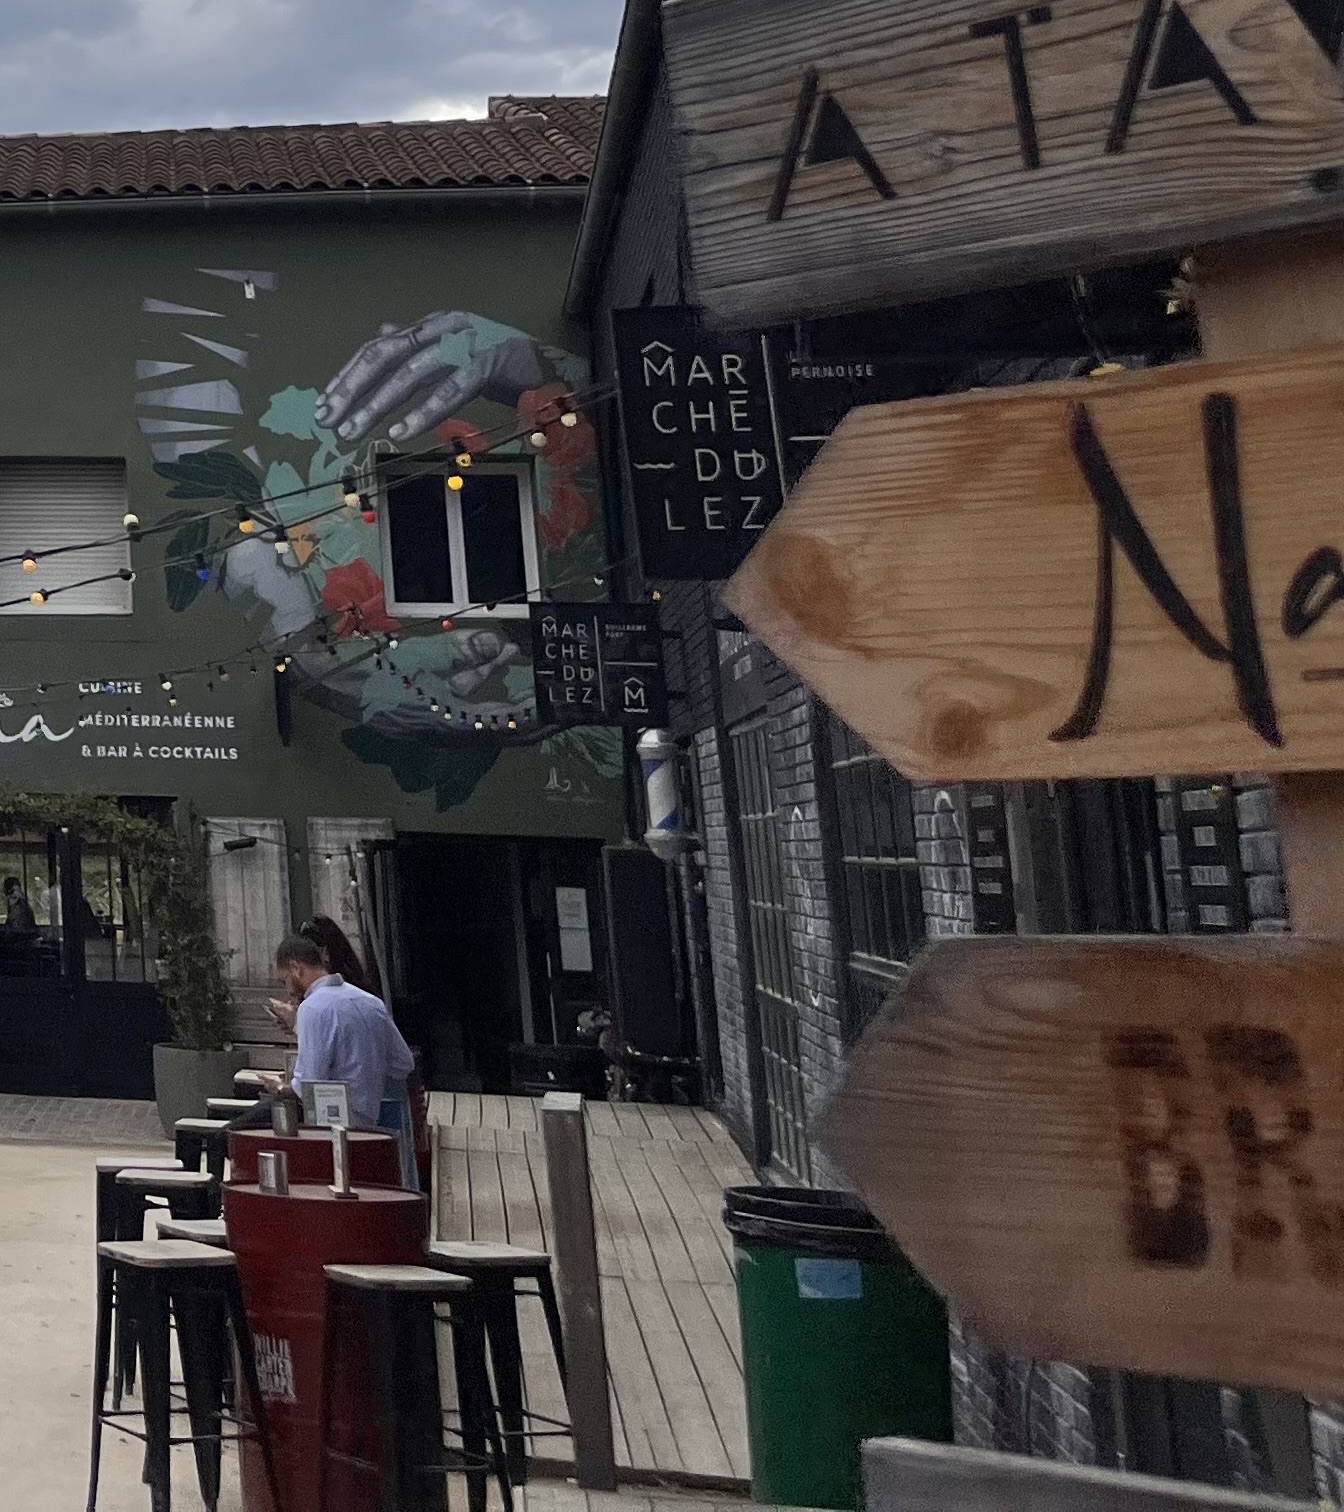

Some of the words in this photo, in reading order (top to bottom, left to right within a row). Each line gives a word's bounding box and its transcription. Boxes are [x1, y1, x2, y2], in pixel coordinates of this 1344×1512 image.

[664, 496, 766, 531] LEZ
[97, 745, 128, 758] BAR
[148, 745, 239, 760] COCKTAILS
